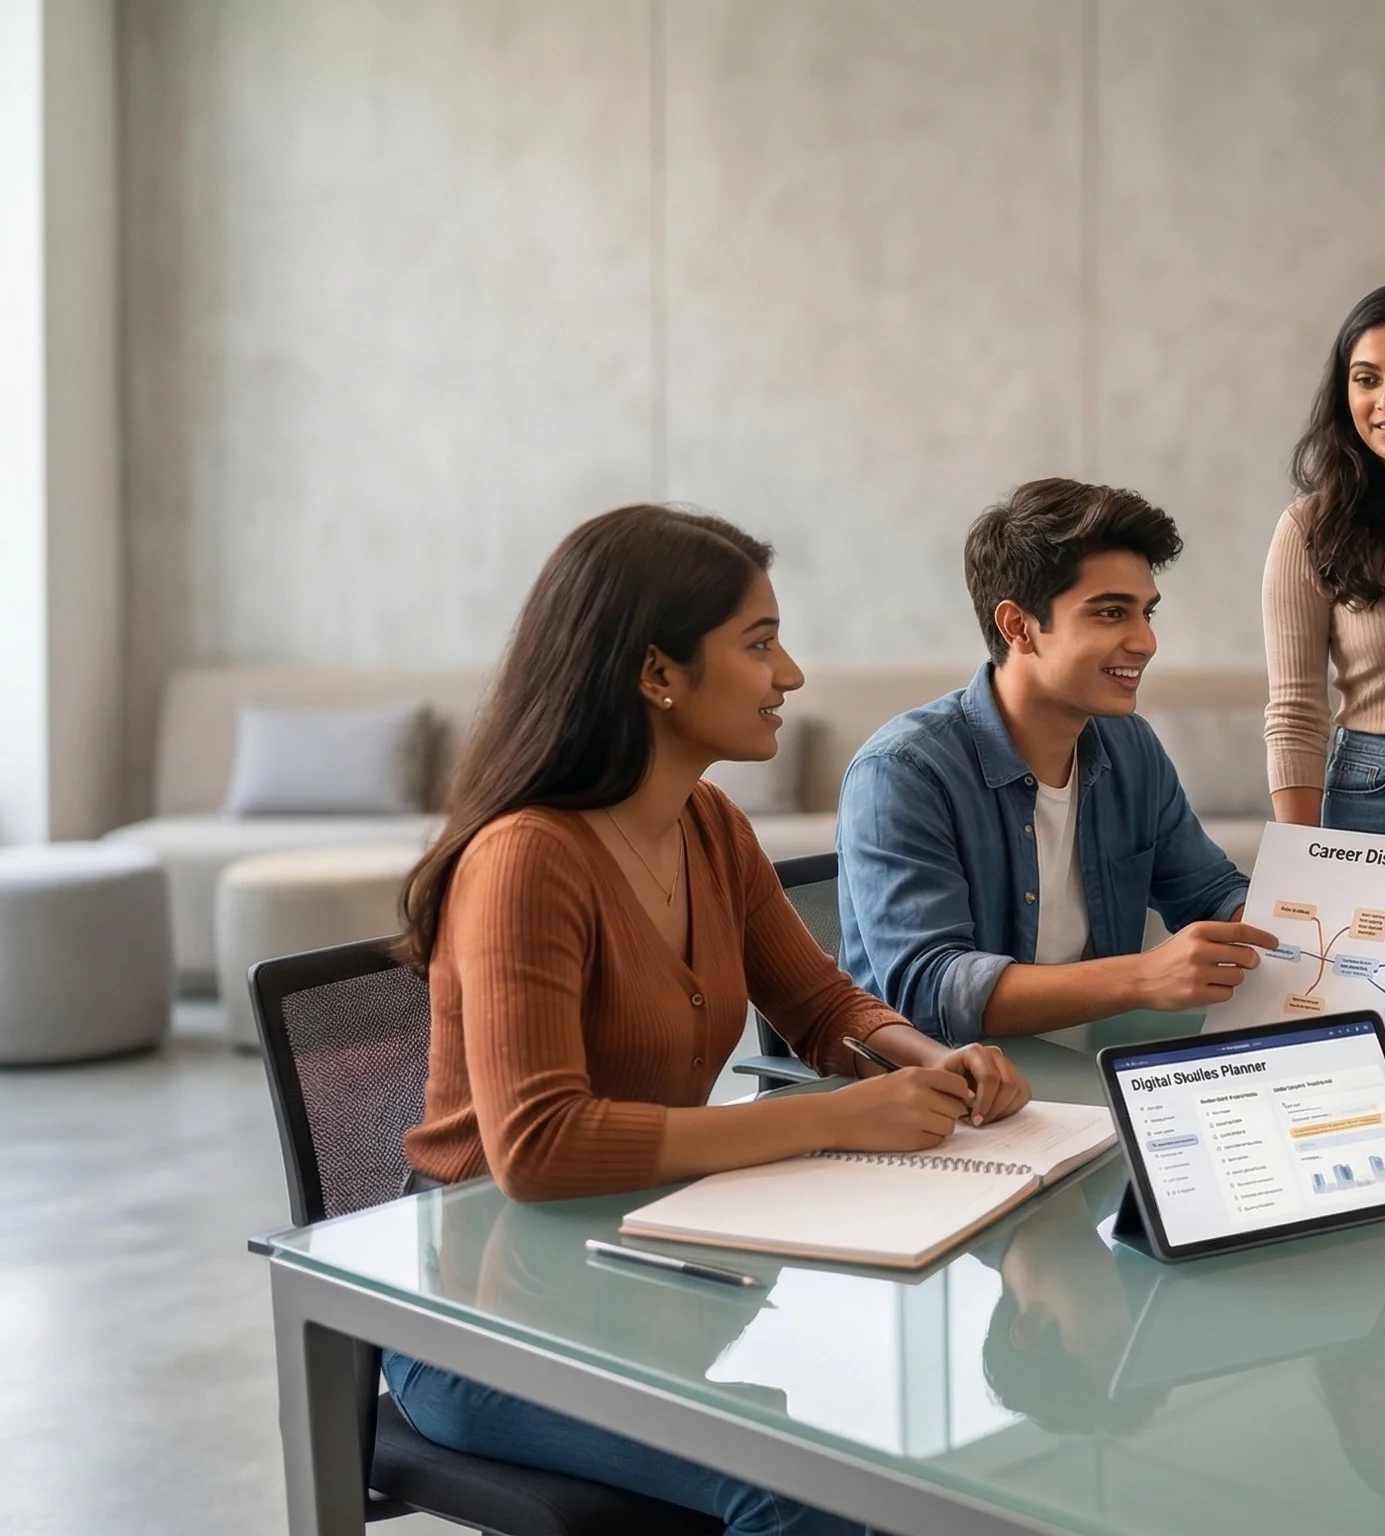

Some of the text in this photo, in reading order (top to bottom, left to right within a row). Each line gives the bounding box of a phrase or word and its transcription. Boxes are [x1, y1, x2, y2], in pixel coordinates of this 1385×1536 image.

[1308, 841, 1363, 863] Career
[1131, 1074, 1172, 1092] Digital
[1220, 1060, 1267, 1078] Planner
